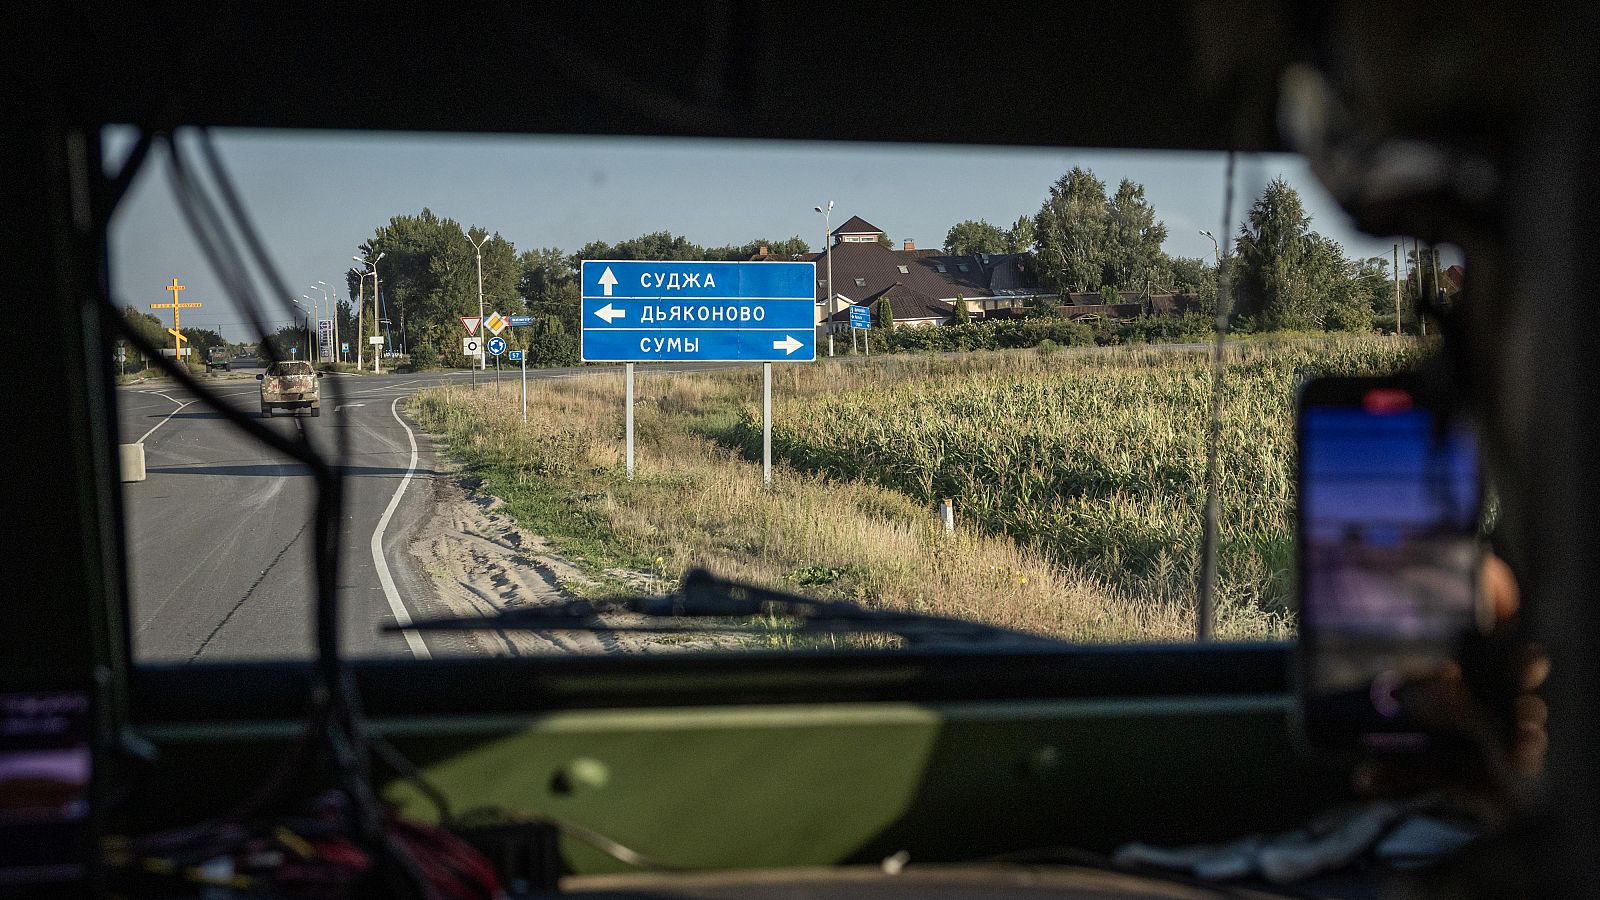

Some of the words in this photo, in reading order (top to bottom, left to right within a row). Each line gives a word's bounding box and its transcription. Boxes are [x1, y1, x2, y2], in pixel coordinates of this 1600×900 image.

[640, 272, 716, 290] СУДЖА
[640, 305, 765, 323] ДЬЯКОНОВО
[640, 337, 700, 353] СУМЫ
